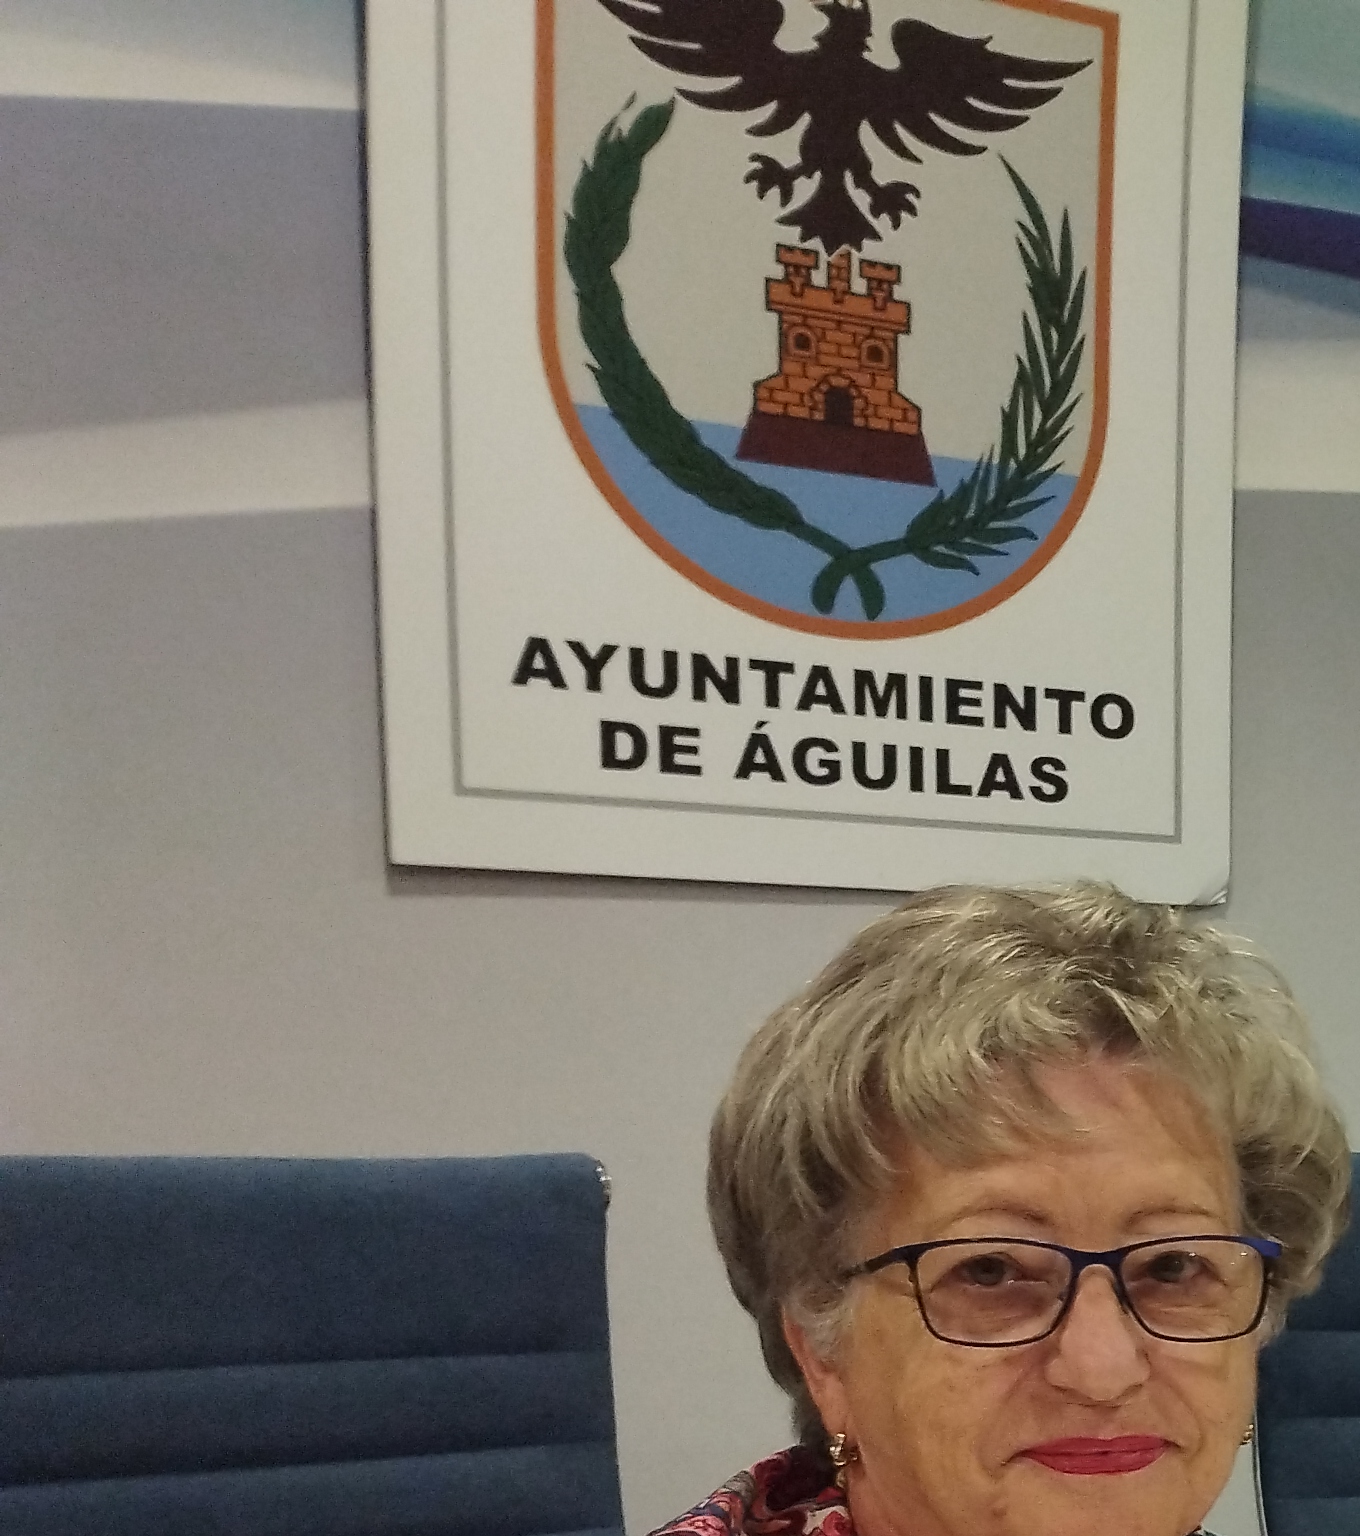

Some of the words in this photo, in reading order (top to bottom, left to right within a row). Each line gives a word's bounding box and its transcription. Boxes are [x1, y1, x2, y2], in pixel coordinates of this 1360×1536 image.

[511, 635, 1136, 741] AYUNTAMIENTO
[599, 718, 704, 777] DE
[733, 722, 1070, 804] ÁGUILAS
